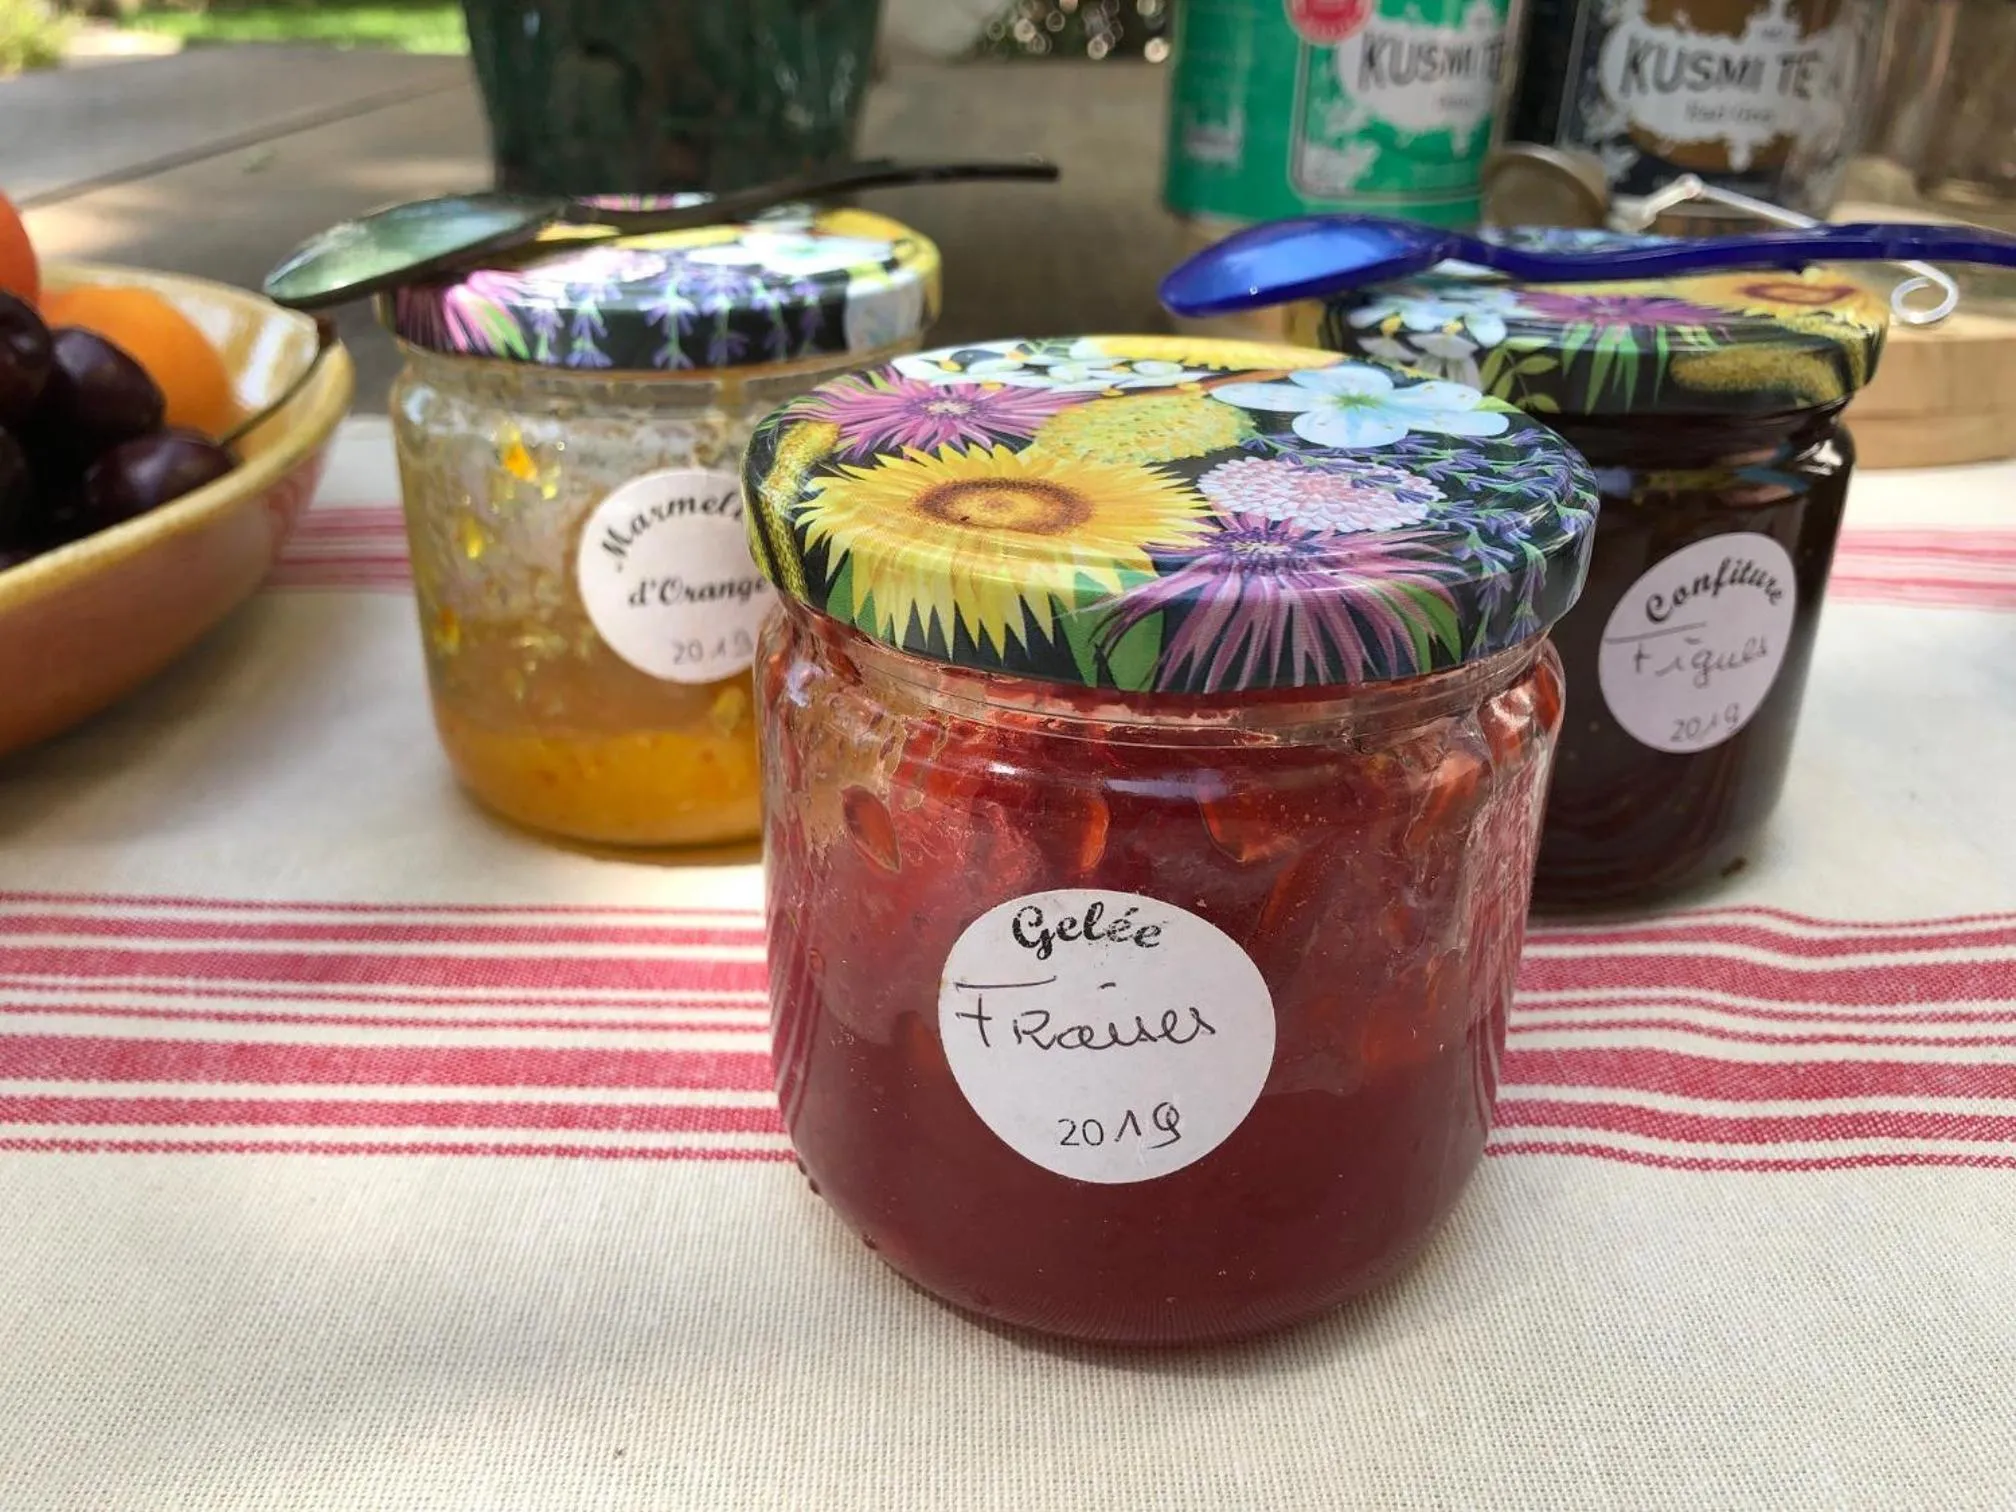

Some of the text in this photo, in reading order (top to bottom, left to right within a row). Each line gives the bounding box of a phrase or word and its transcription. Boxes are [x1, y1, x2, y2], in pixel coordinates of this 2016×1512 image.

[1619, 34, 1766, 98] KUSMI
[602, 491, 743, 573] Marmel
[1645, 556, 1783, 623] Confiture
[1669, 702, 1741, 742] 2019
[1012, 901, 1163, 960] Gelée
[1057, 1102, 1182, 1150] 2019
